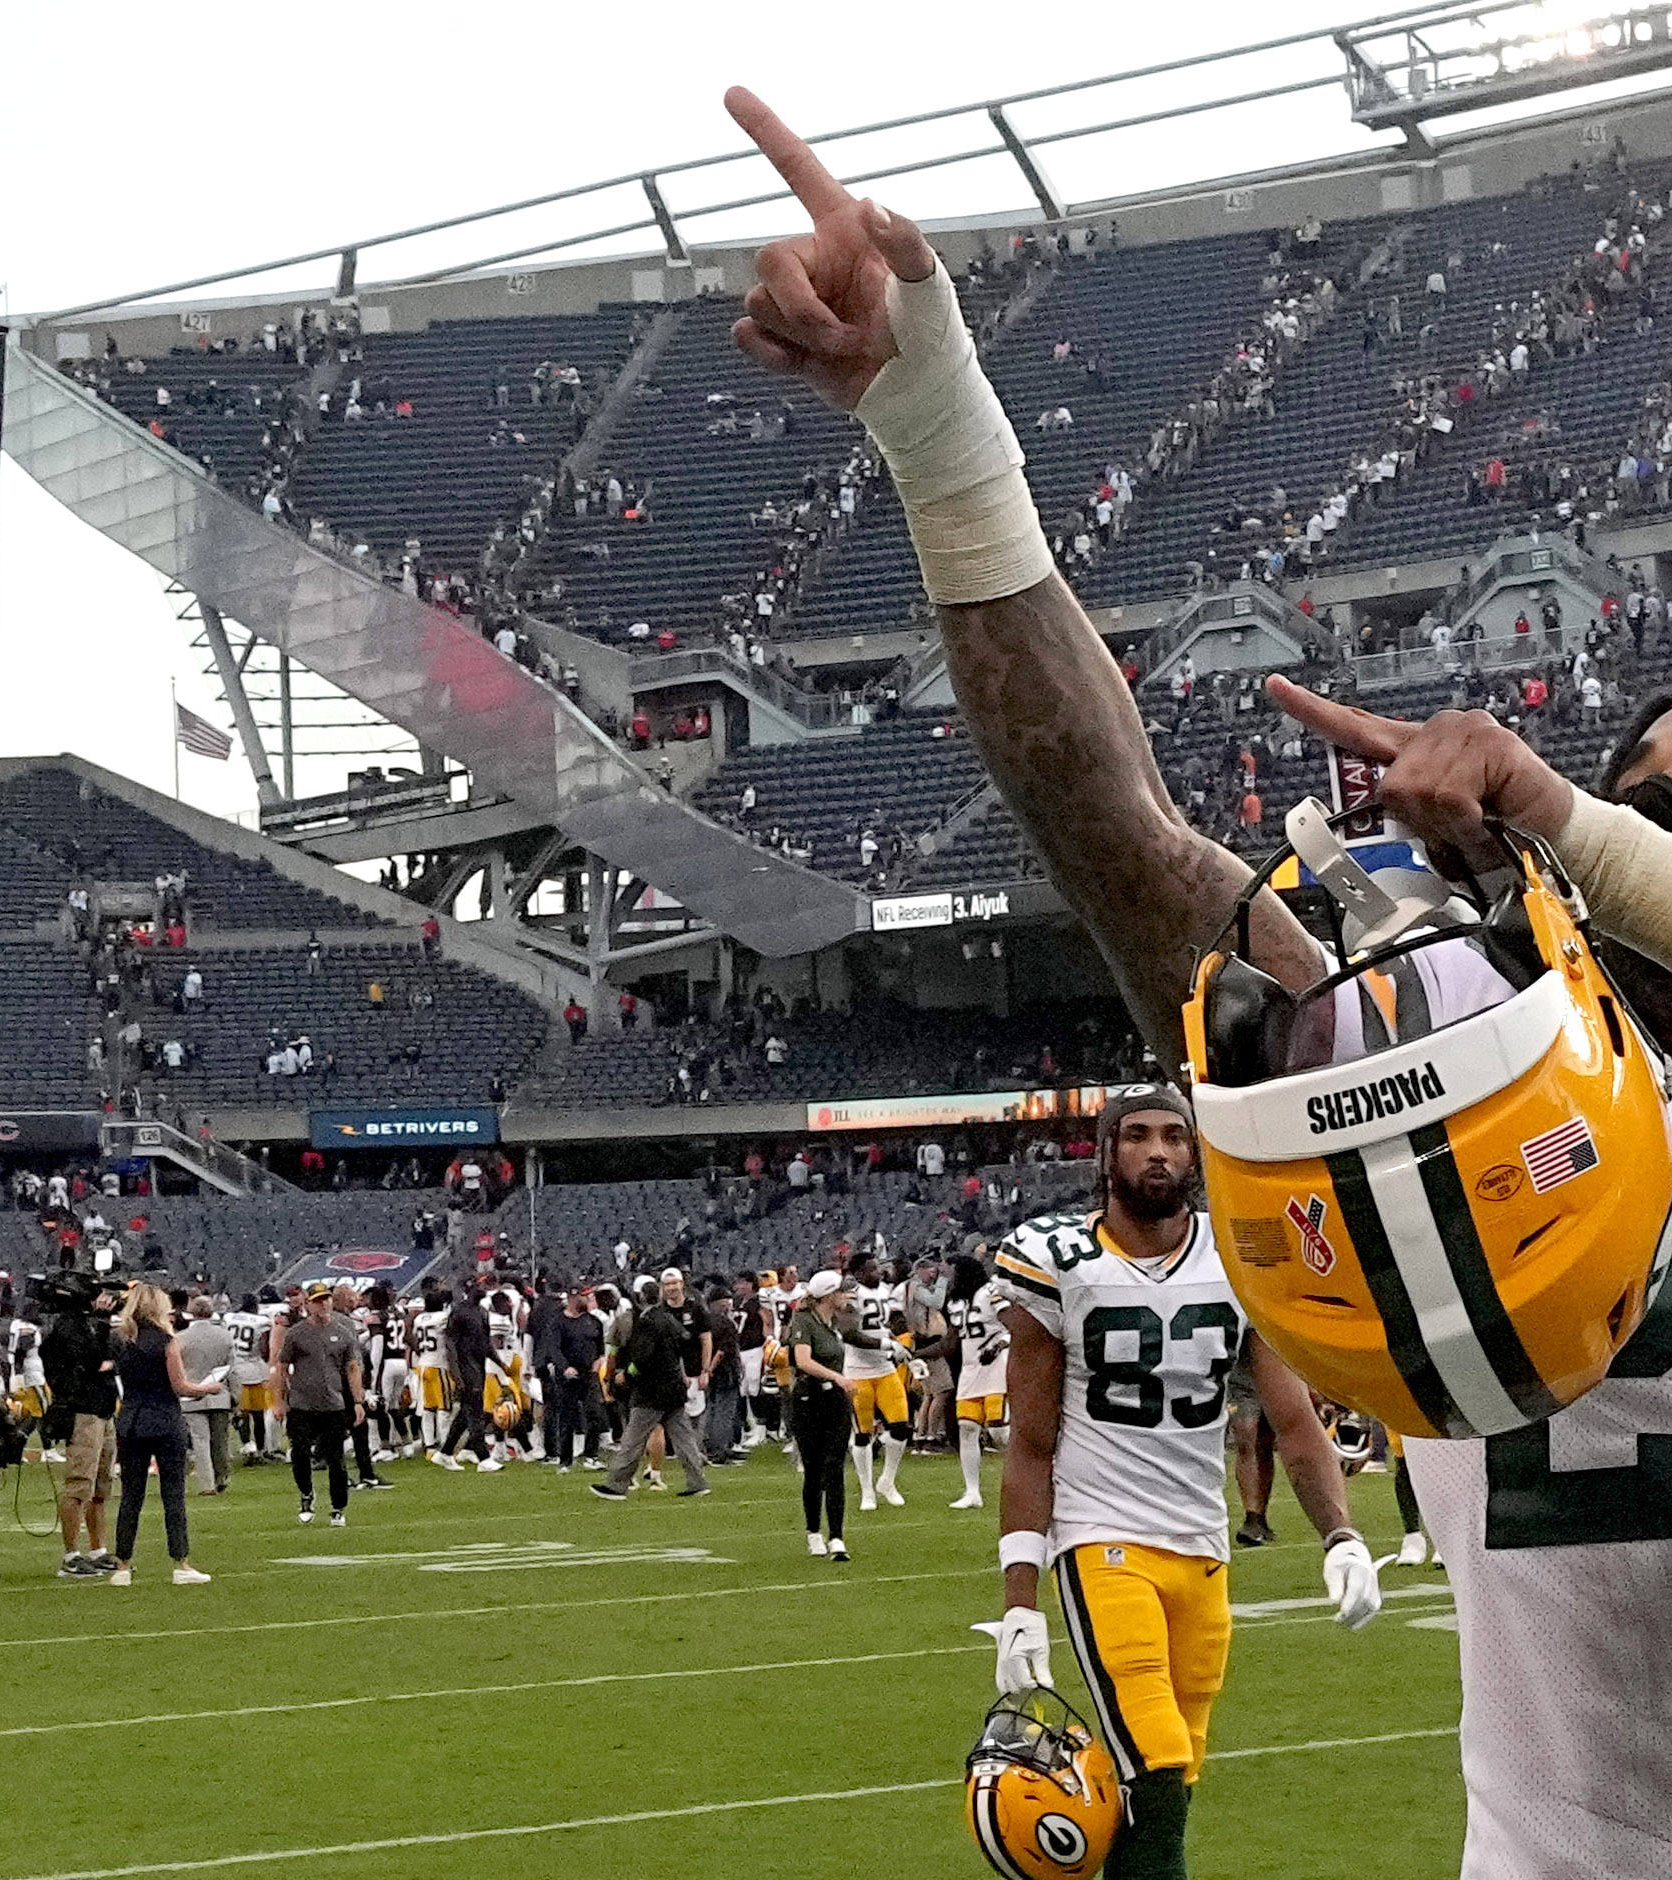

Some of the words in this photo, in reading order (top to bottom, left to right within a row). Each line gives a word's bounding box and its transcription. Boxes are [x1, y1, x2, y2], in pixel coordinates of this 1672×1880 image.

[877, 906, 895, 923] NFL
[898, 904, 949, 921] Receiving
[953, 896, 969, 919] 3.
[970, 891, 1009, 920] Aiyuk
[1307, 1061, 1447, 1135] PACKERS
[366, 1121, 479, 1135] BETRIVERS
[833, 1109, 851, 1122] JLL
[385, 1319, 407, 1350] 32
[1083, 1301, 1240, 1428] 83
